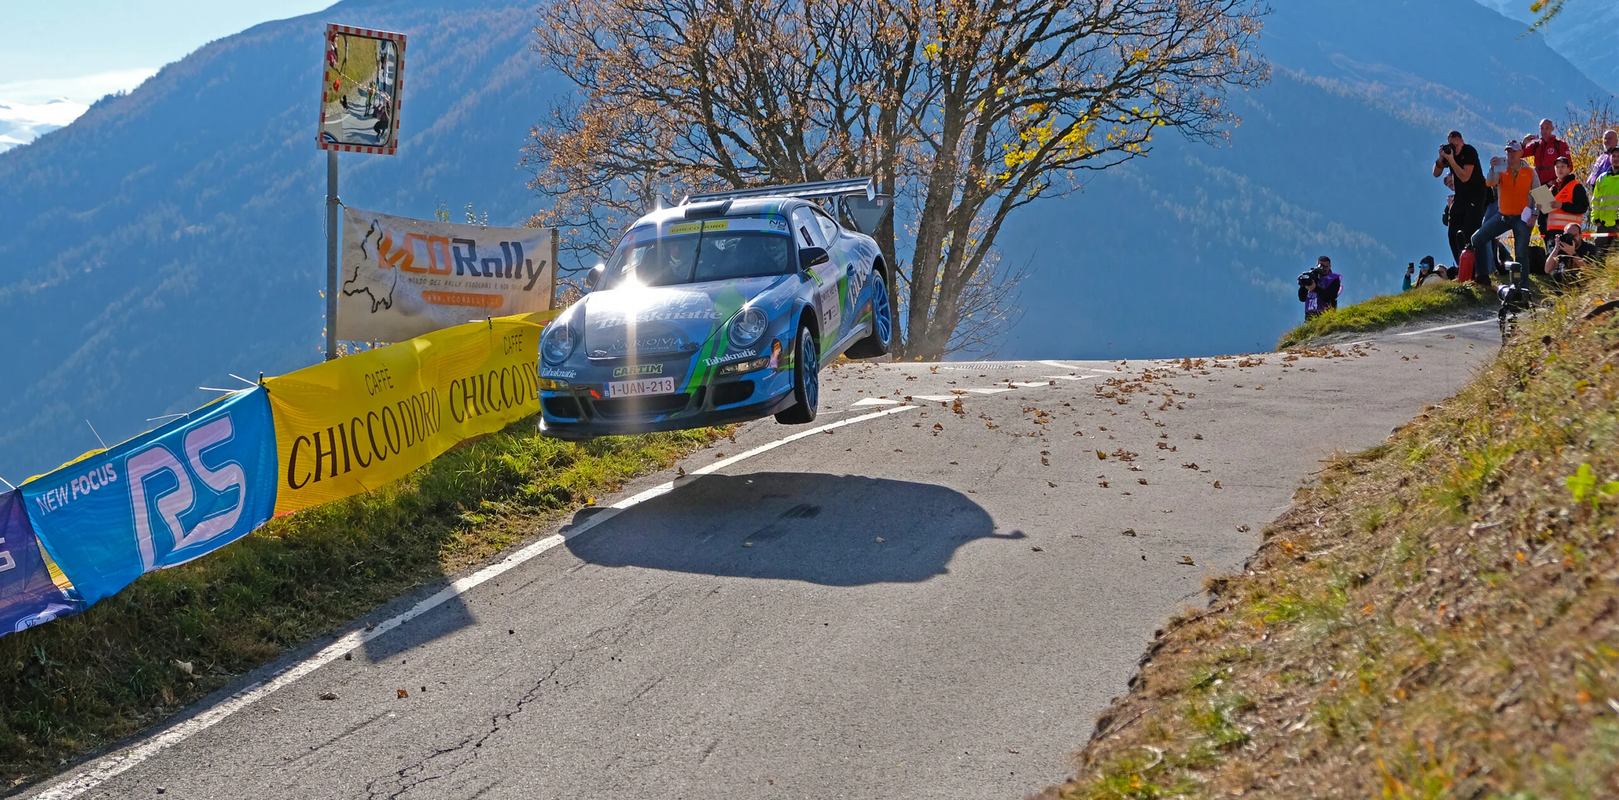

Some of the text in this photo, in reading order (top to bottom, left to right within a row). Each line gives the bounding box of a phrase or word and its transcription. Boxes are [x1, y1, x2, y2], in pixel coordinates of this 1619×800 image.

[703, 349, 757, 366] Tabaknatie
[364, 363, 394, 397] CAFFÈ
[613, 364, 663, 377] CARTIM
[611, 379, 673, 396] 1-UAN-213
[36, 462, 117, 515] NEW FOCUS
[126, 412, 246, 574] RS
